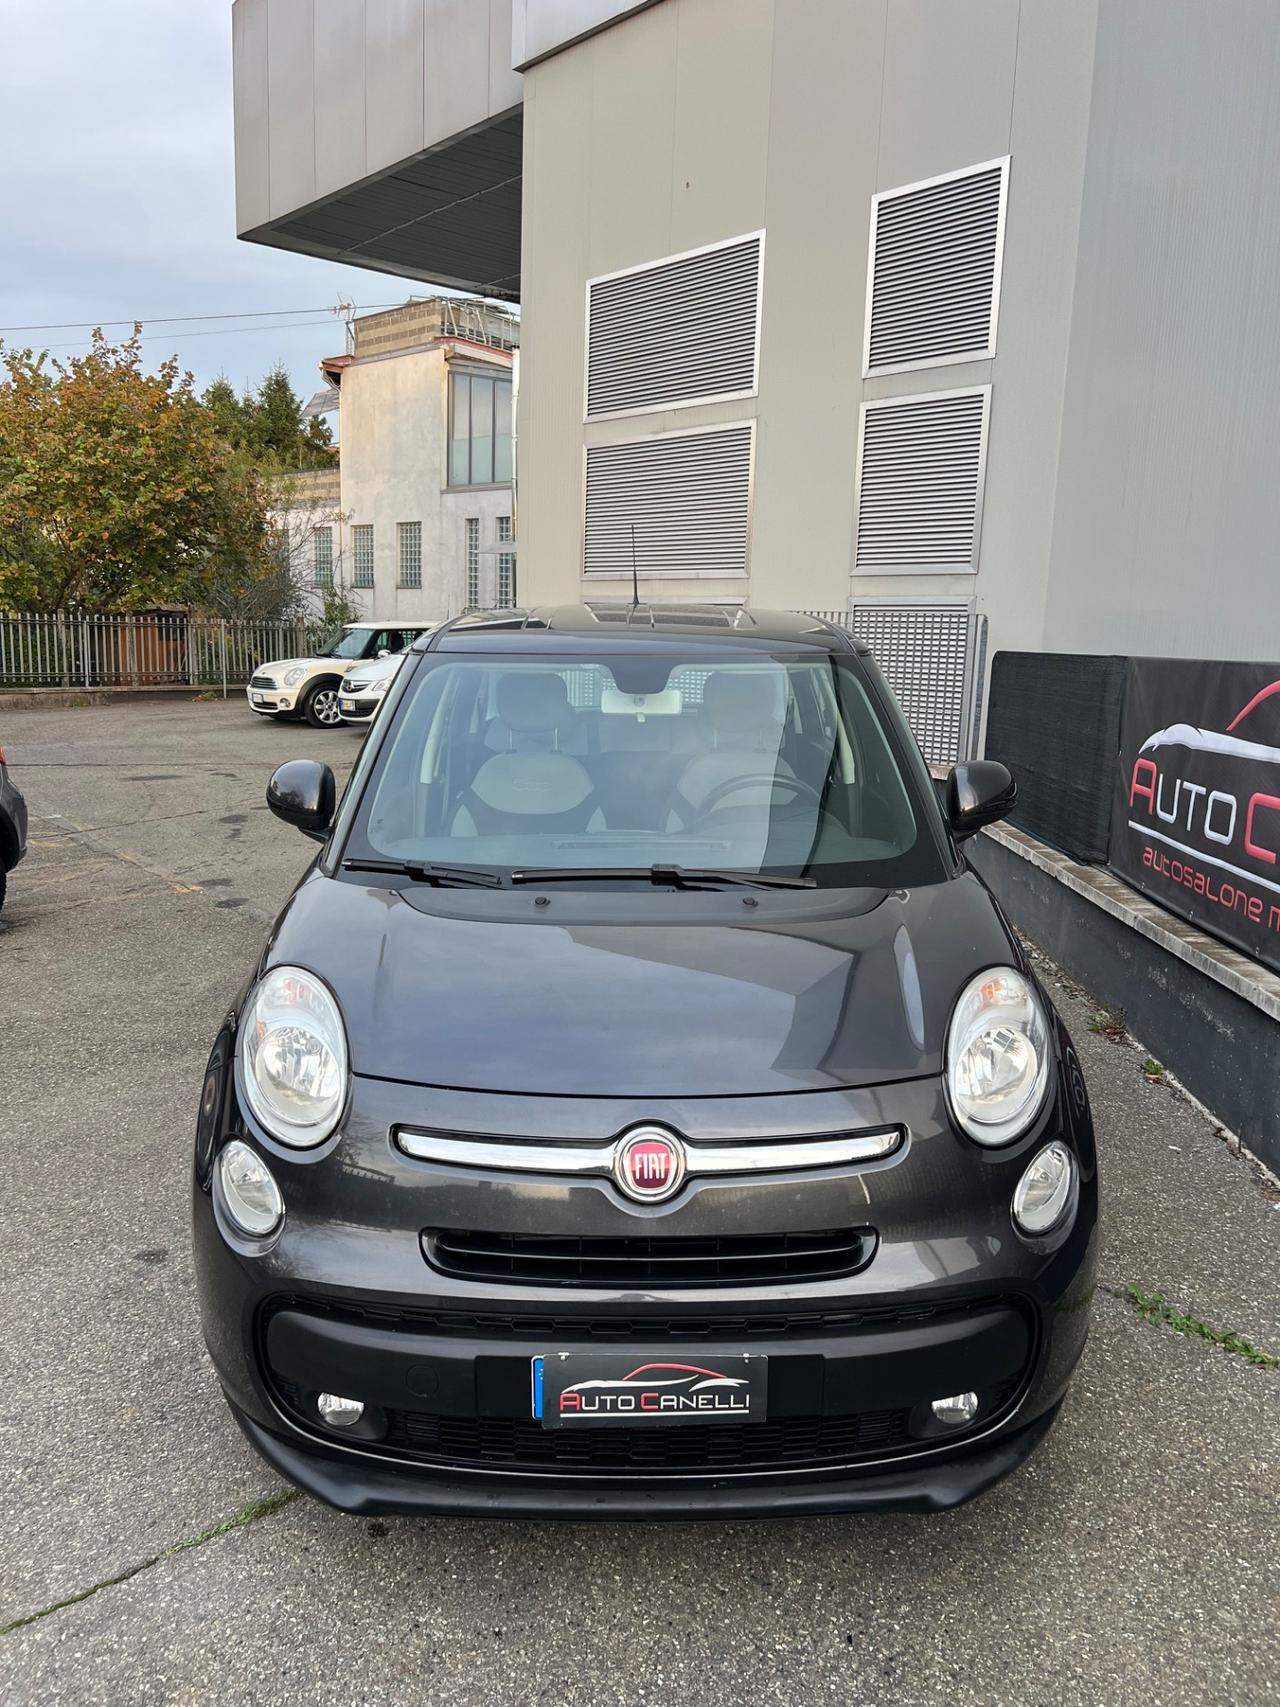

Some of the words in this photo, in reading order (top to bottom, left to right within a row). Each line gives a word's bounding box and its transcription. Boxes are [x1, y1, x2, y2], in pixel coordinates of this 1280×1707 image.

[1129, 757, 1237, 846] AUTO
[1142, 846, 1264, 923] autosalone
[634, 1152, 668, 1180] FIAT
[559, 1392, 635, 1411] AUTO
[640, 1392, 750, 1410] CANELLI
